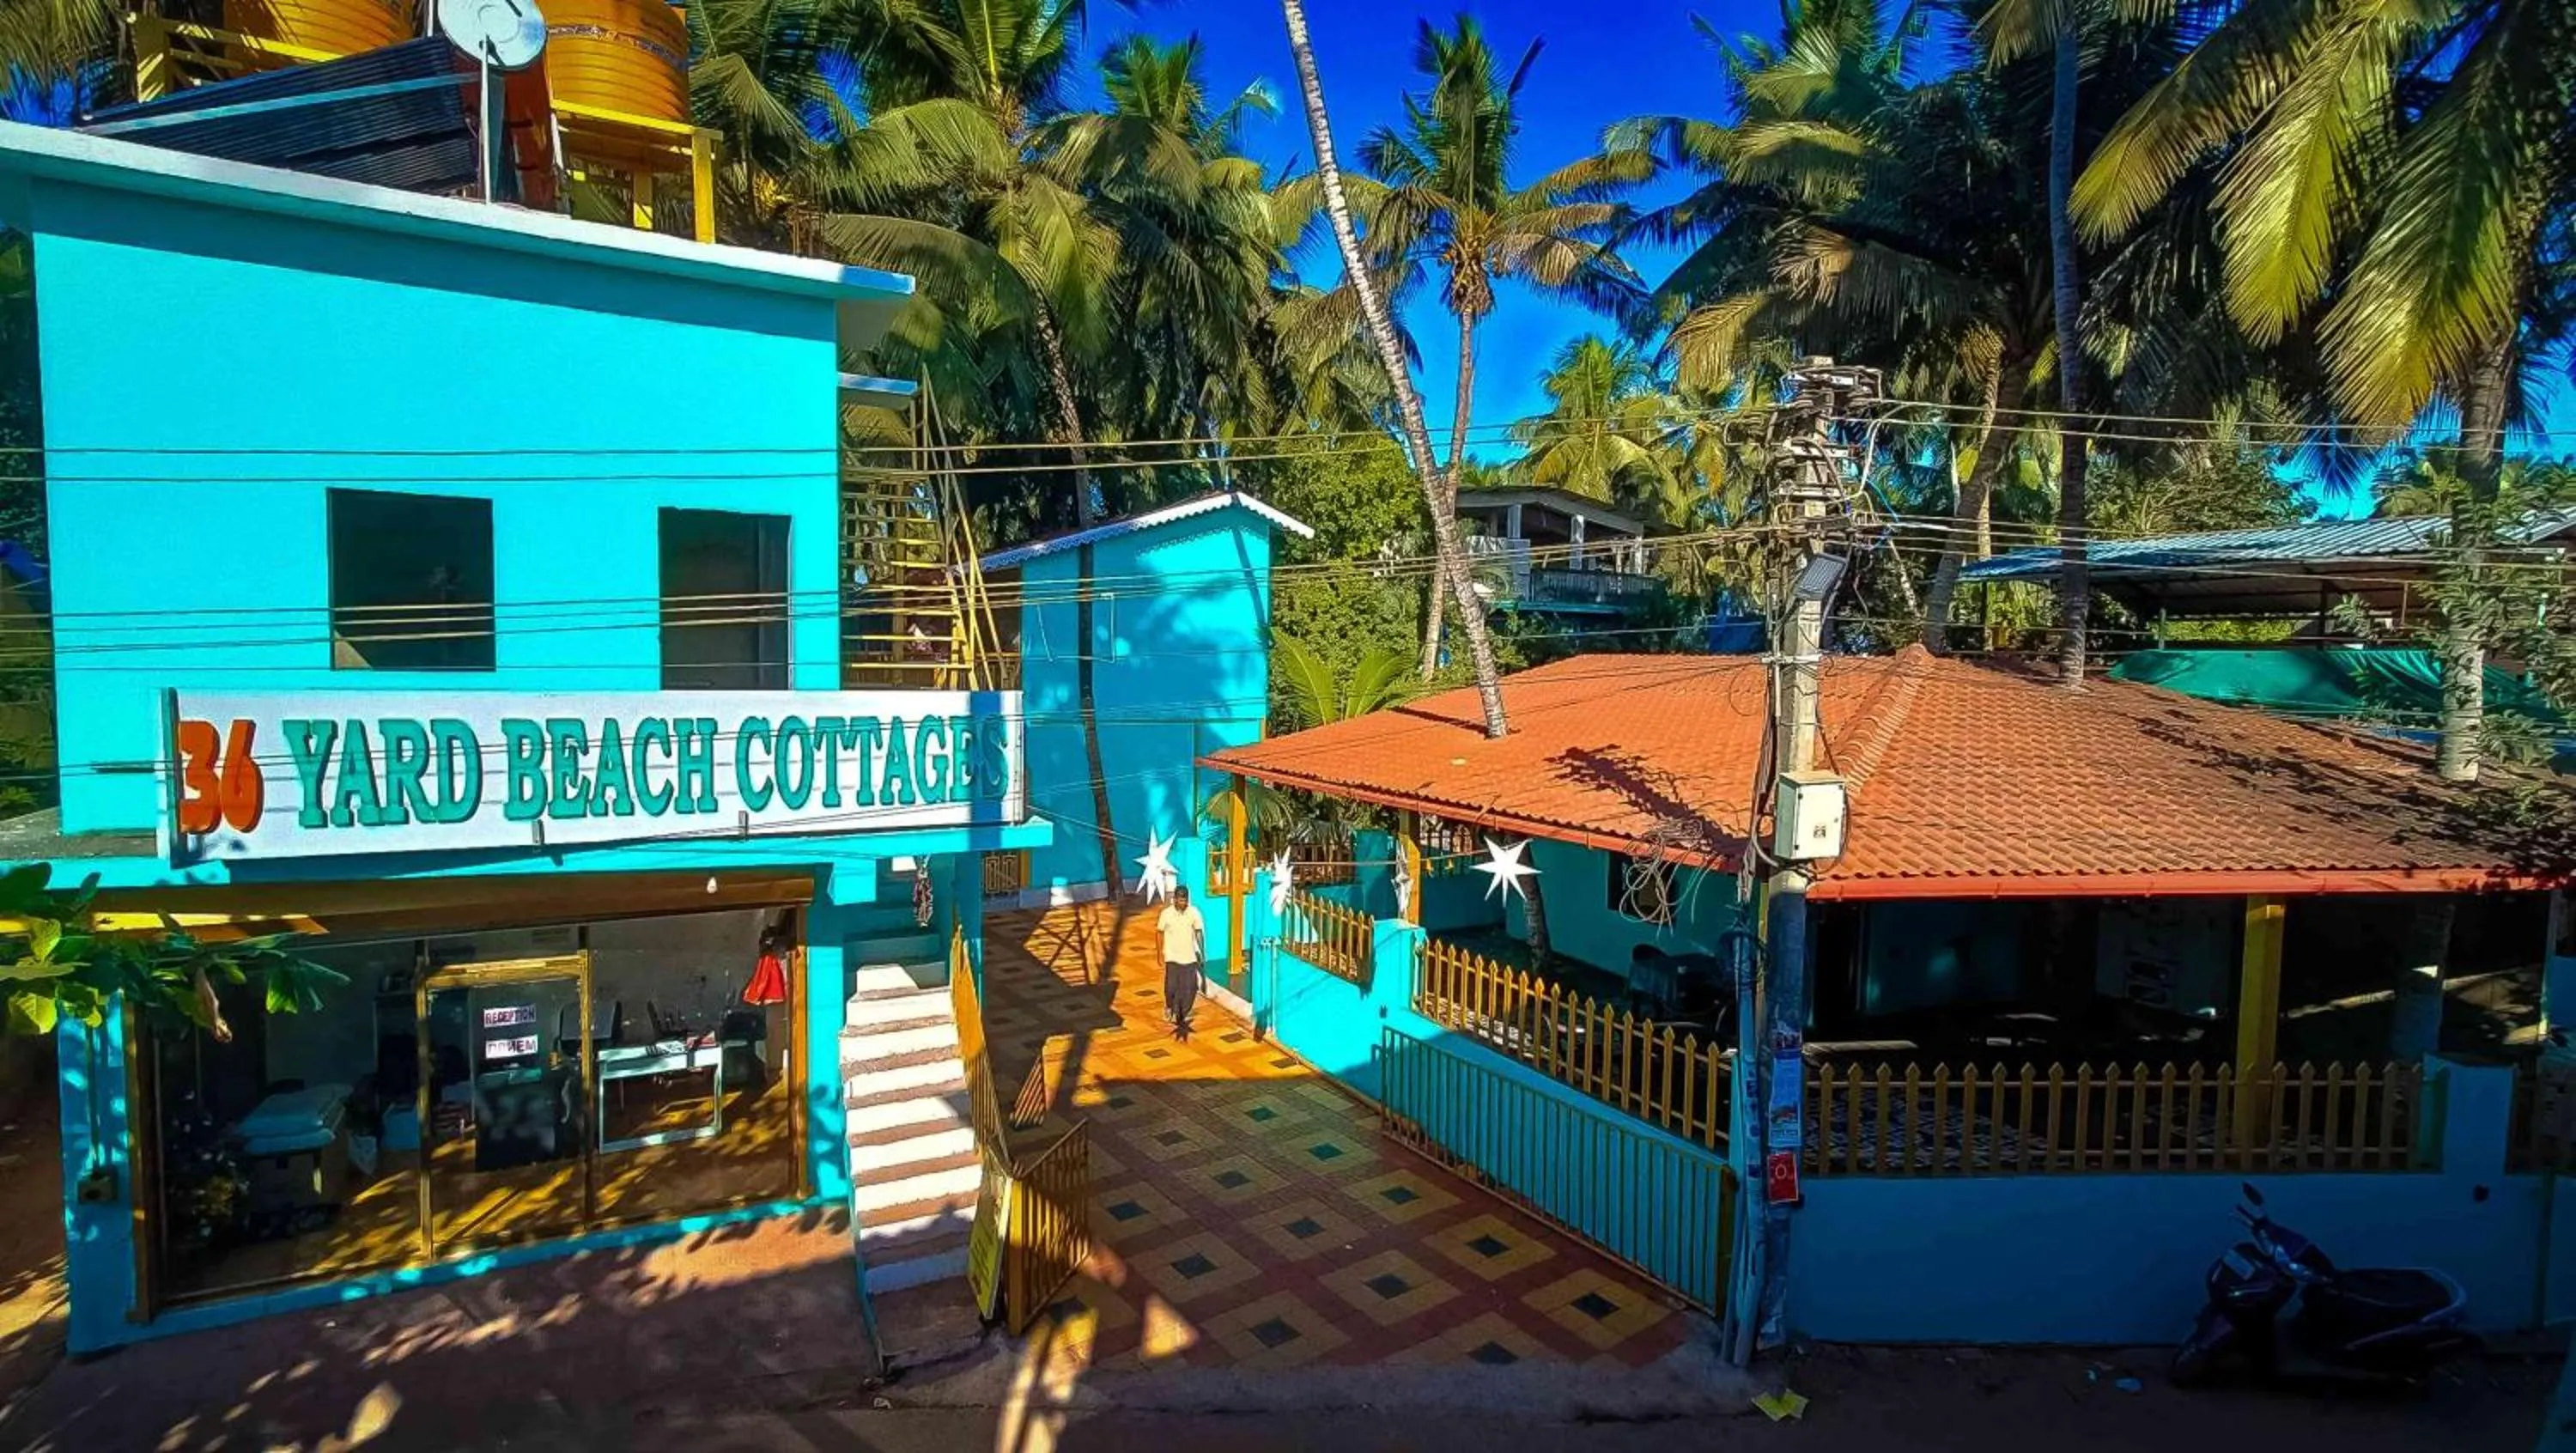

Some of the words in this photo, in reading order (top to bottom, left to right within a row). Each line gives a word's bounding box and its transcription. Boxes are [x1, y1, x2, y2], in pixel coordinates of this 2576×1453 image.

[179, 719, 264, 835] 36
[282, 718, 483, 829] YARD
[501, 716, 719, 821] BEACH
[735, 714, 1008, 812] COTTAGES
